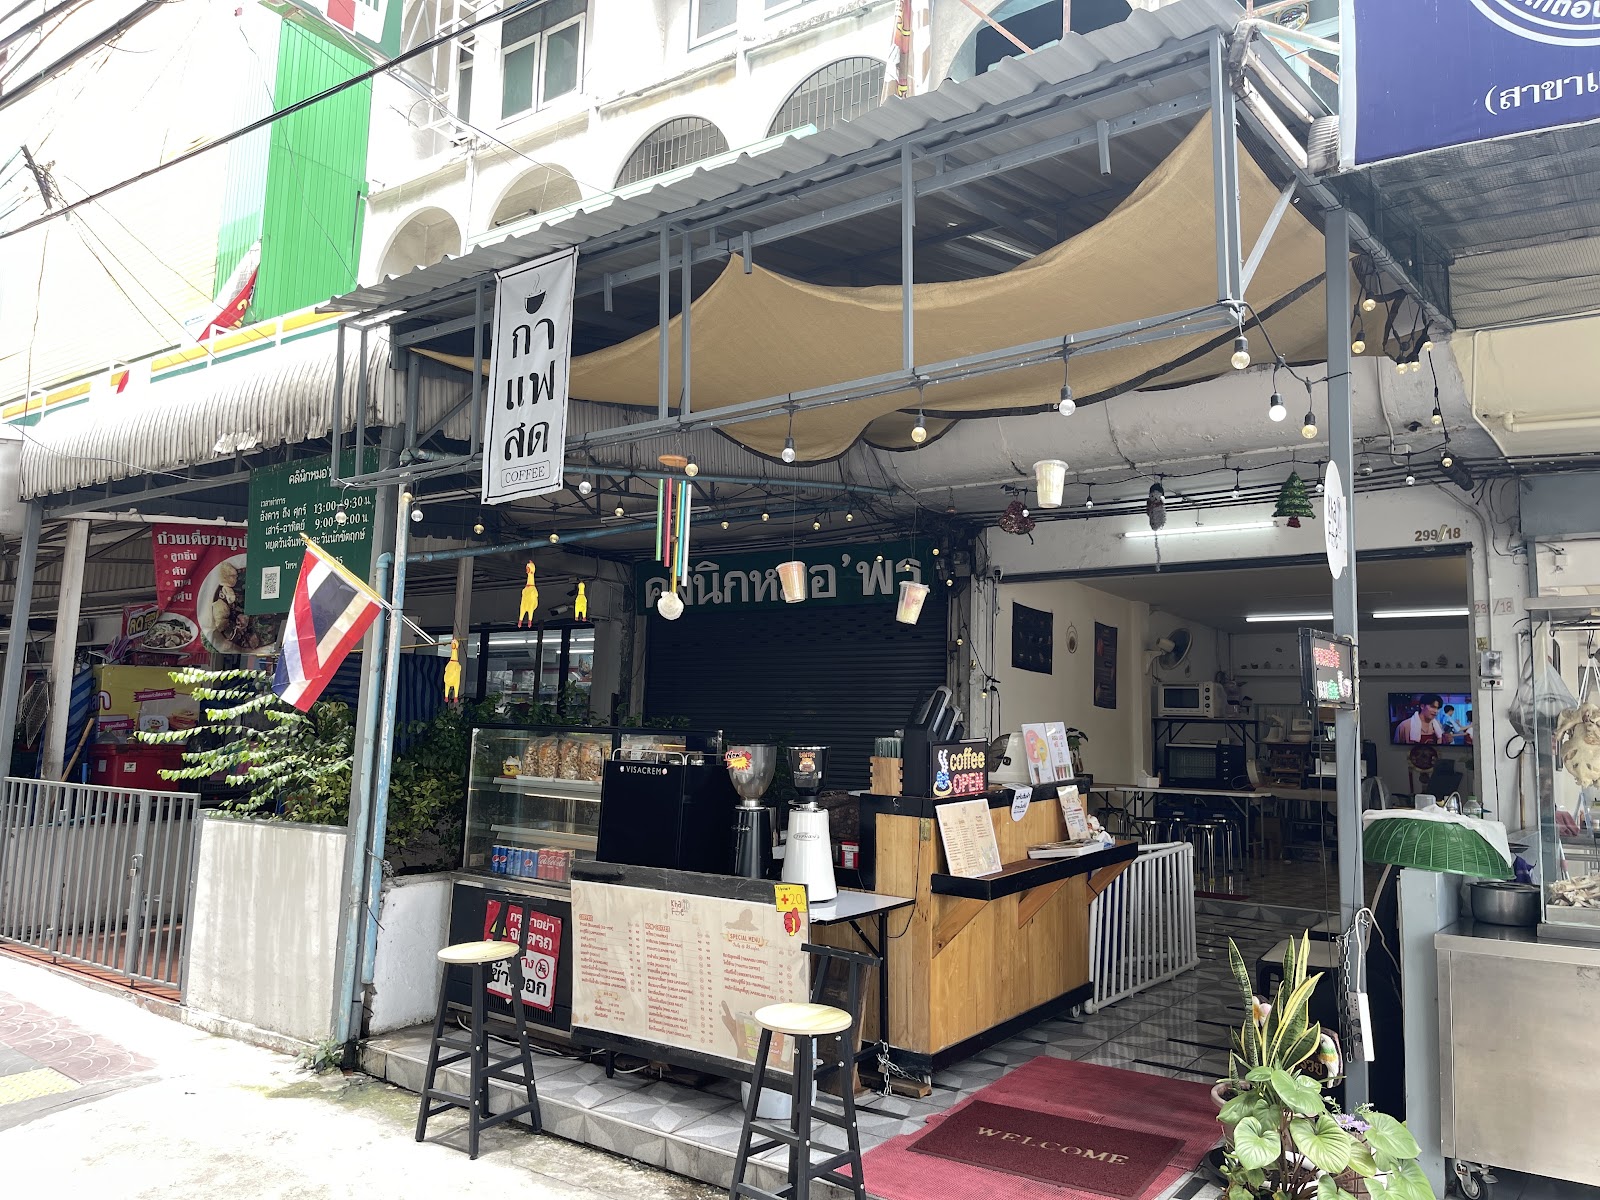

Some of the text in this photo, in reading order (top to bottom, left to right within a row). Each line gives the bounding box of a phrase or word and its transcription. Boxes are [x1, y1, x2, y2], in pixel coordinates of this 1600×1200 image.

[1484, 71, 1600, 116] (สาขาเ
[512, 317, 556, 359] กา
[506, 359, 556, 411] แฟ
[503, 421, 550, 462] สด
[505, 464, 546, 484] COFFEE
[260, 508, 280, 522] อังคาร
[282, 506, 291, 518] ถึง
[293, 502, 307, 519] ศุกร์
[313, 496, 363, 515] 13:00-9:30
[1414, 524, 1461, 542] 299/18
[1474, 600, 1513, 614] 29/18
[626, 765, 662, 776] VISACREM
[950, 746, 986, 772] coffee
[953, 771, 984, 794] OPEN
[978, 1126, 1130, 1165] WELCOME
